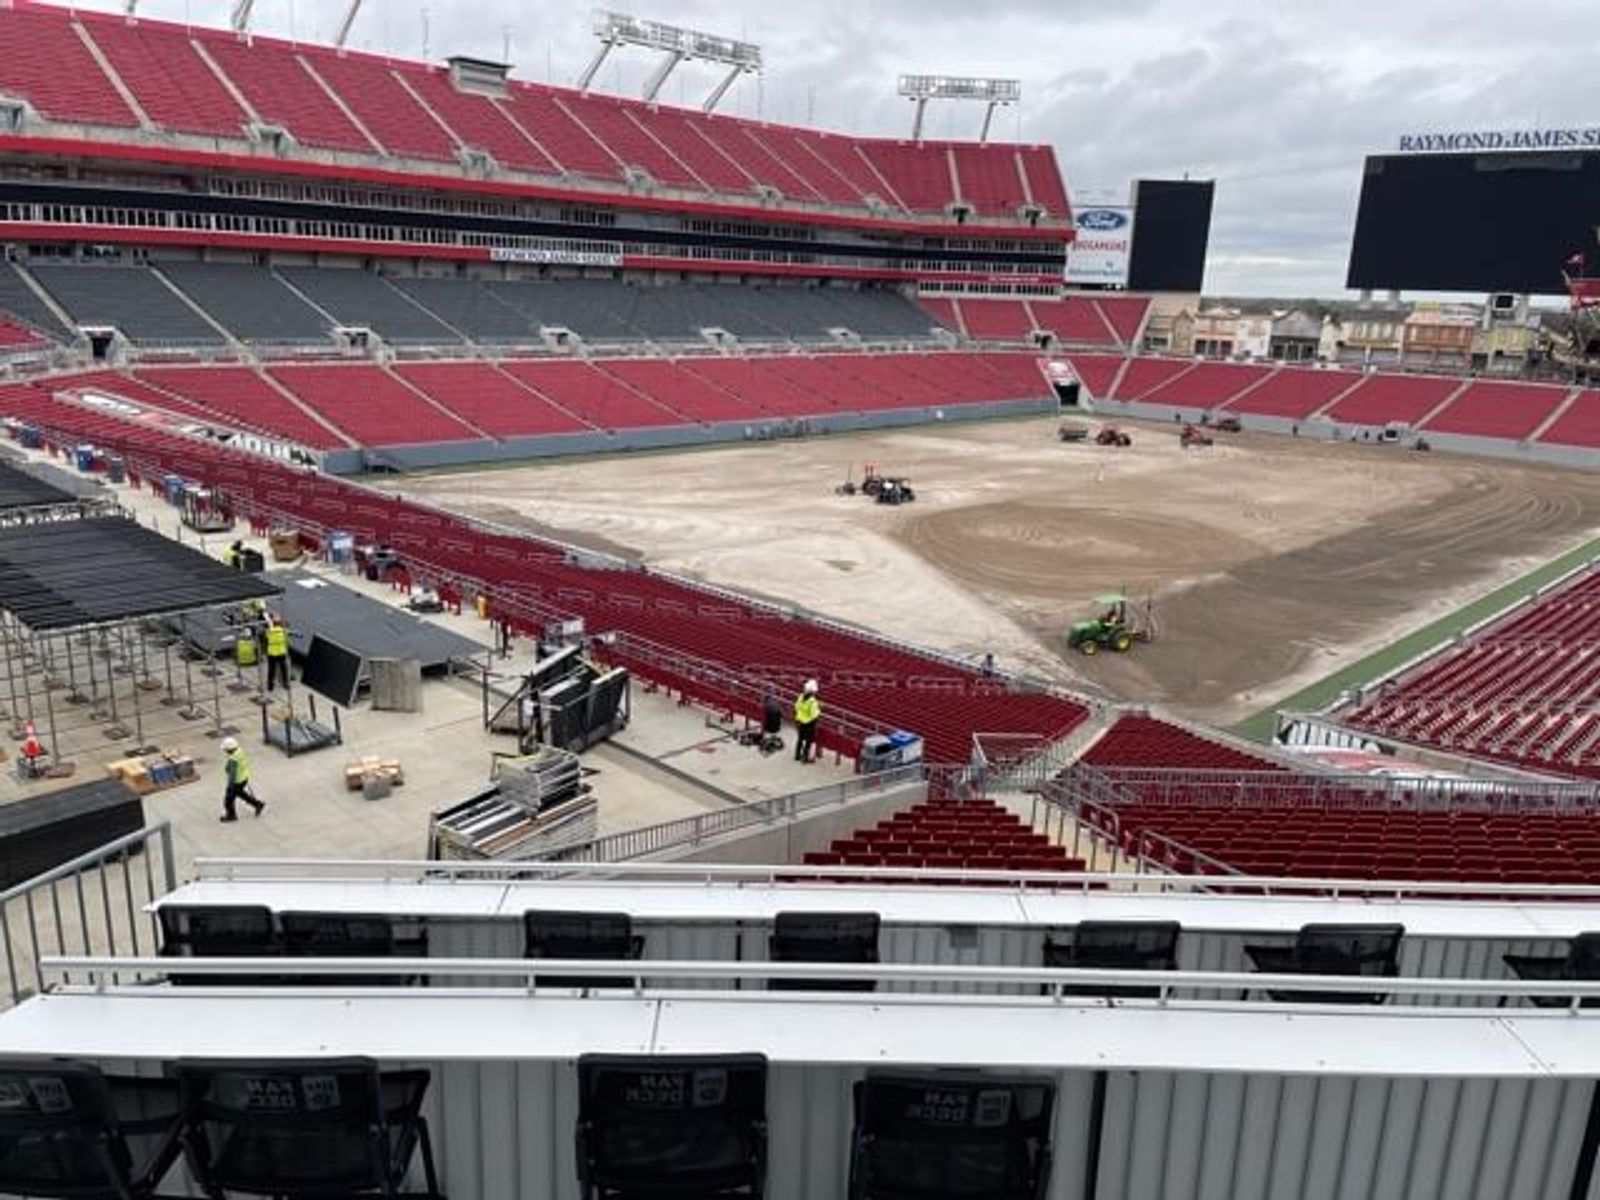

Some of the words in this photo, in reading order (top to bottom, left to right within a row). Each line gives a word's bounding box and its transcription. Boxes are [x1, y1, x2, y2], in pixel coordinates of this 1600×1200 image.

[1399, 132, 1504, 152] RAYMOND
[1505, 130, 1578, 148] JAMES
[1583, 129, 1600, 146] S
